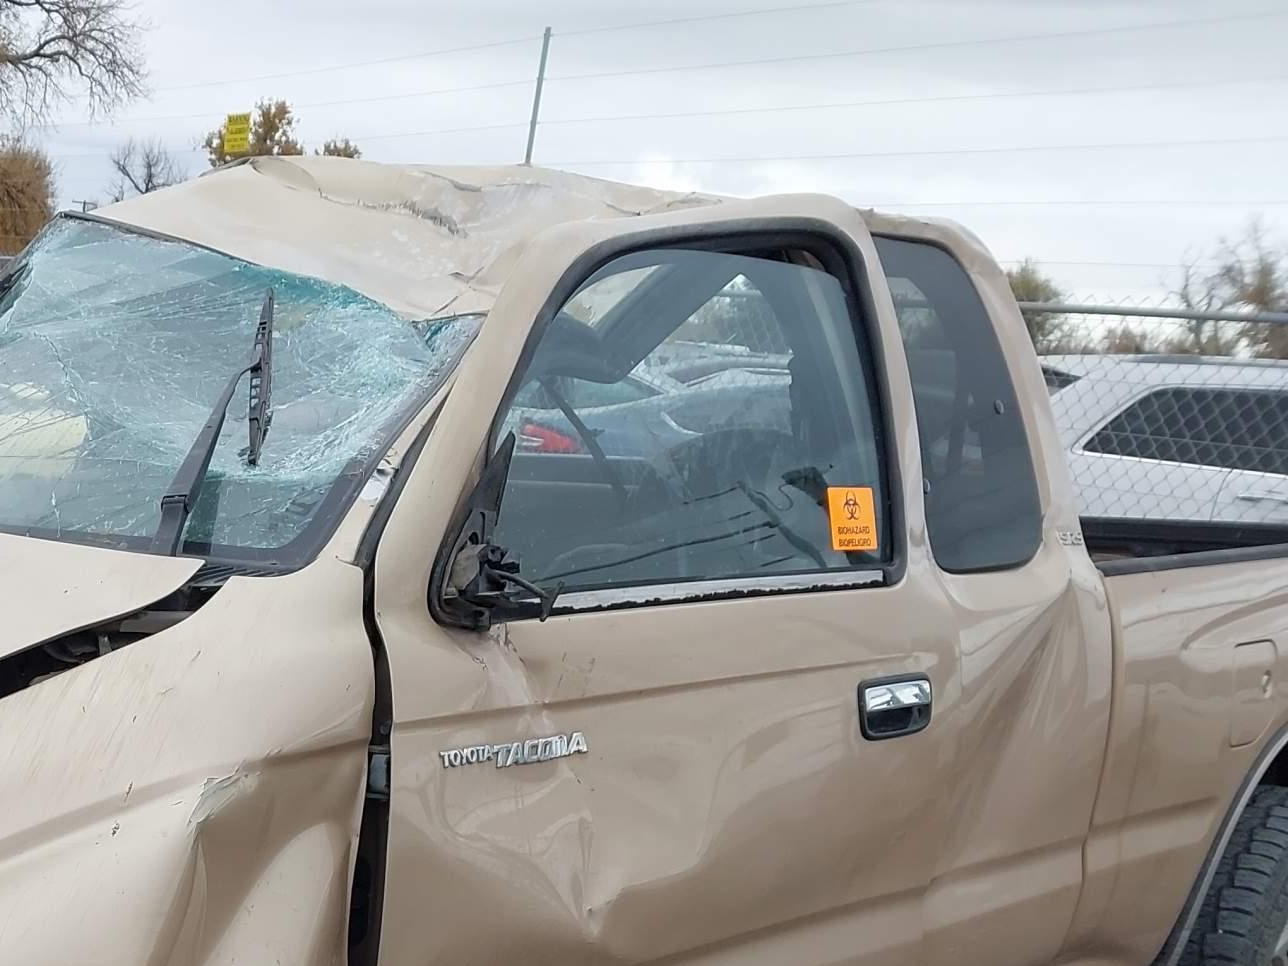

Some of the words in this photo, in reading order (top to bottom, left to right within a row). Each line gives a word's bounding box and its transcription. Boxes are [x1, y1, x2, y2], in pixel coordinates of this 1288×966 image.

[837, 526, 871, 535] BIOHAZARD
[838, 538, 872, 547] BIOPELIGRO
[440, 744, 493, 768] TOYOTA
[493, 731, 588, 768] TACOMA
